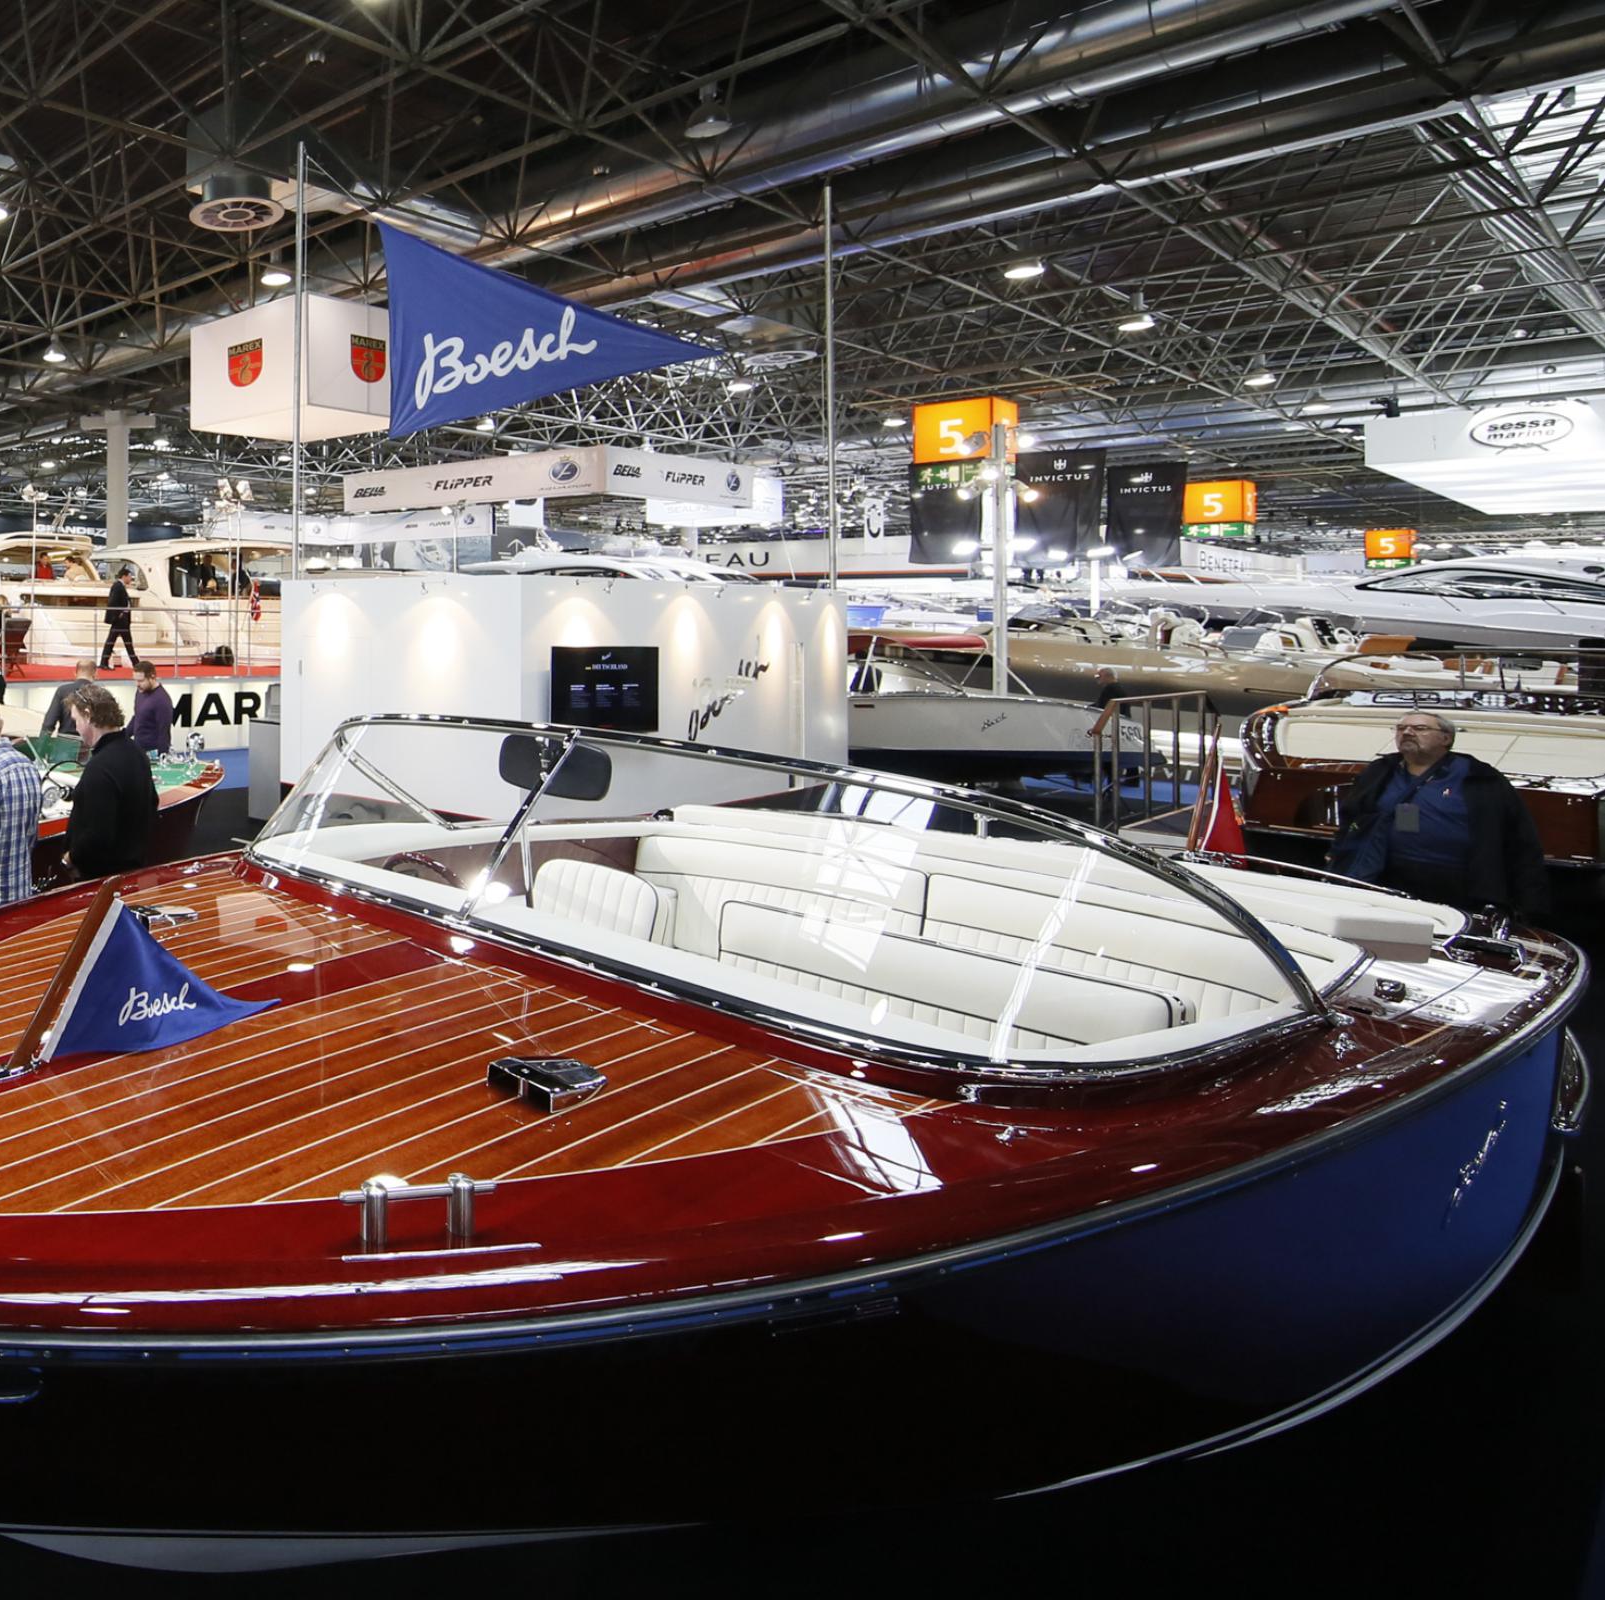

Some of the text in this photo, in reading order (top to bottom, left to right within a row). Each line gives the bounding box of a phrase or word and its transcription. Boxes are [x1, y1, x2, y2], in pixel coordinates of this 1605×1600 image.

[229, 340, 262, 355] MAREX
[351, 335, 385, 349] MAREX
[414, 305, 598, 411] Boesch
[1487, 417, 1557, 432] sessa
[939, 418, 966, 455] 5
[1486, 428, 1555, 440] marine
[613, 464, 642, 478] BELLA
[1029, 473, 1091, 483] INVICTUS
[353, 486, 387, 498] BELLA
[1120, 485, 1172, 494] INVICTUS
[1203, 493, 1224, 517] 5
[1379, 538, 1395, 555] 5
[118, 981, 197, 1026] Boesch
